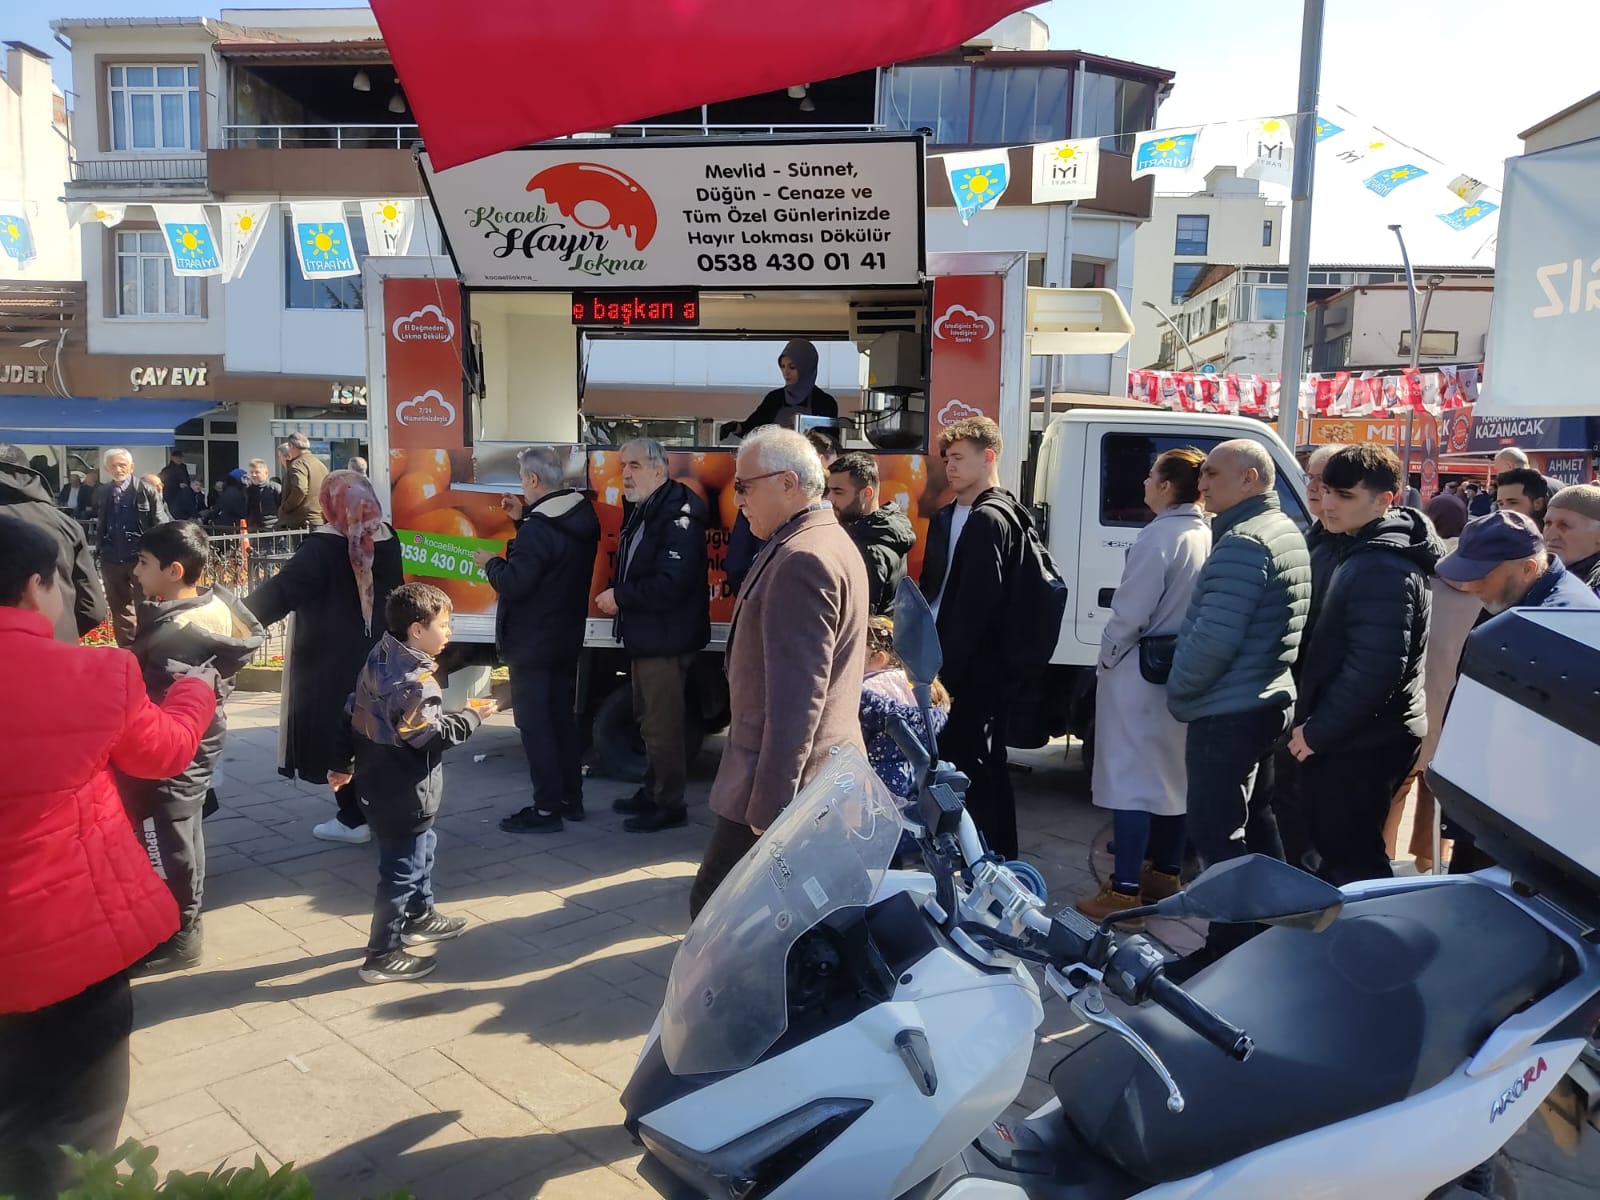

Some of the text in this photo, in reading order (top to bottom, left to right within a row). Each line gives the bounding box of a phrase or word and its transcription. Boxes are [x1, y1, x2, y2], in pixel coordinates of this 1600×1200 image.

[705, 163, 766, 178] Mevlid
[788, 162, 858, 178] Sünnet,
[696, 187, 756, 205] Düğün
[777, 186, 845, 201] Cenaze
[851, 187, 873, 199] ve
[464, 205, 548, 232] Kocaeli
[682, 206, 890, 224] Tüm Özel Günlerinizde
[485, 223, 609, 262] Hayır
[688, 228, 892, 247] Hayır Lokması Dökülür
[568, 253, 647, 276] Lokma
[697, 252, 886, 272] 0538 430 01 41
[573, 297, 695, 326] e başkan a
[130, 361, 208, 392] ÇAY EVİ
[1475, 419, 1544, 439] KAZANACAK
[1548, 458, 1585, 472] AHMET
[430, 552, 456, 571] 430
[459, 559, 474, 576] 01
[1489, 1056, 1548, 1124] ARORA
